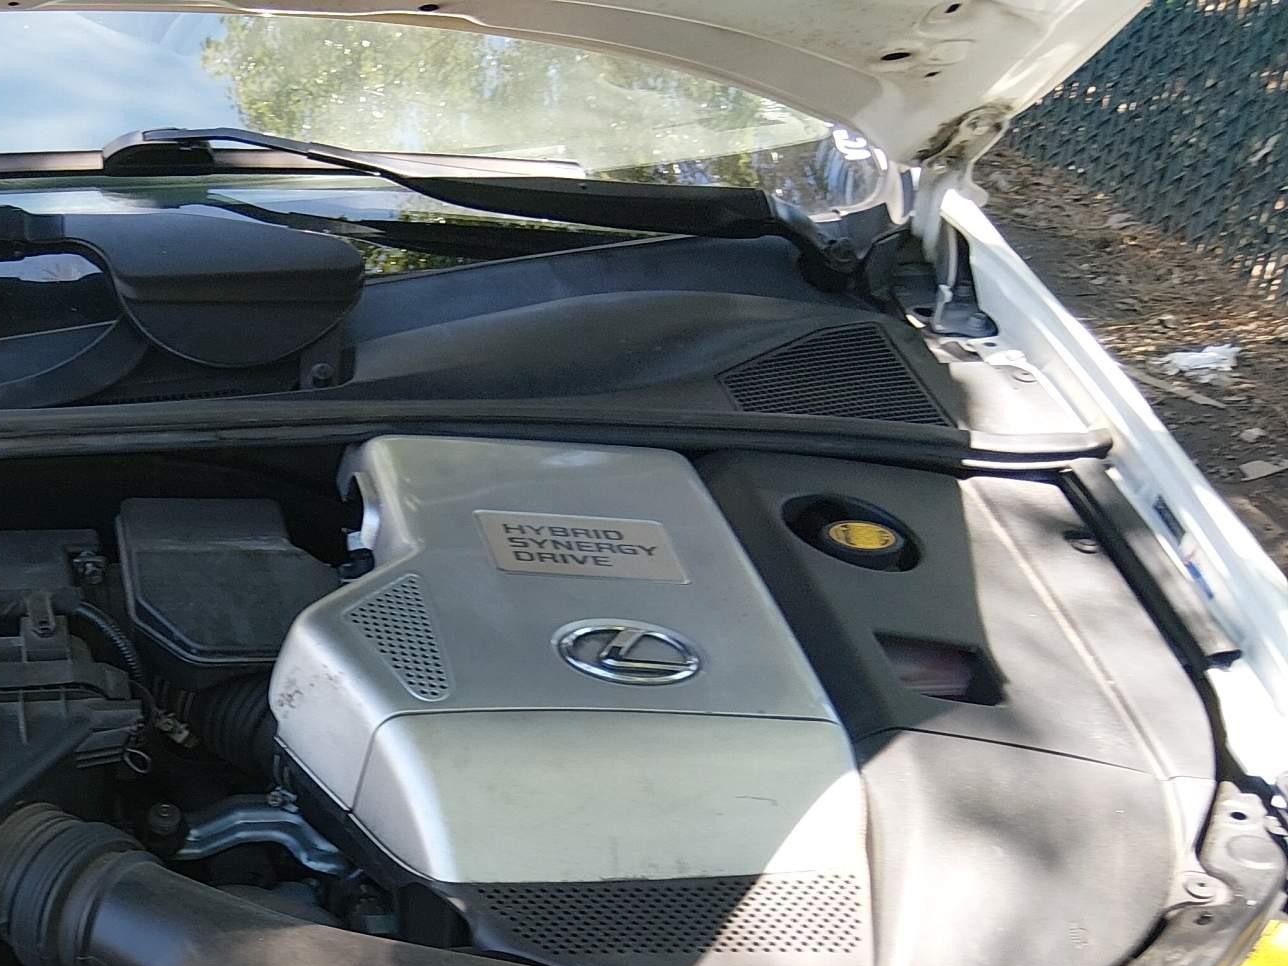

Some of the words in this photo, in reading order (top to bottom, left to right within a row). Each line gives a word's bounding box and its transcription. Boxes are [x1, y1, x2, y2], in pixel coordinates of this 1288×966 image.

[502, 523, 624, 541] HYBRID
[507, 537, 657, 557] SYNERGY
[514, 550, 613, 567] DRIVE
